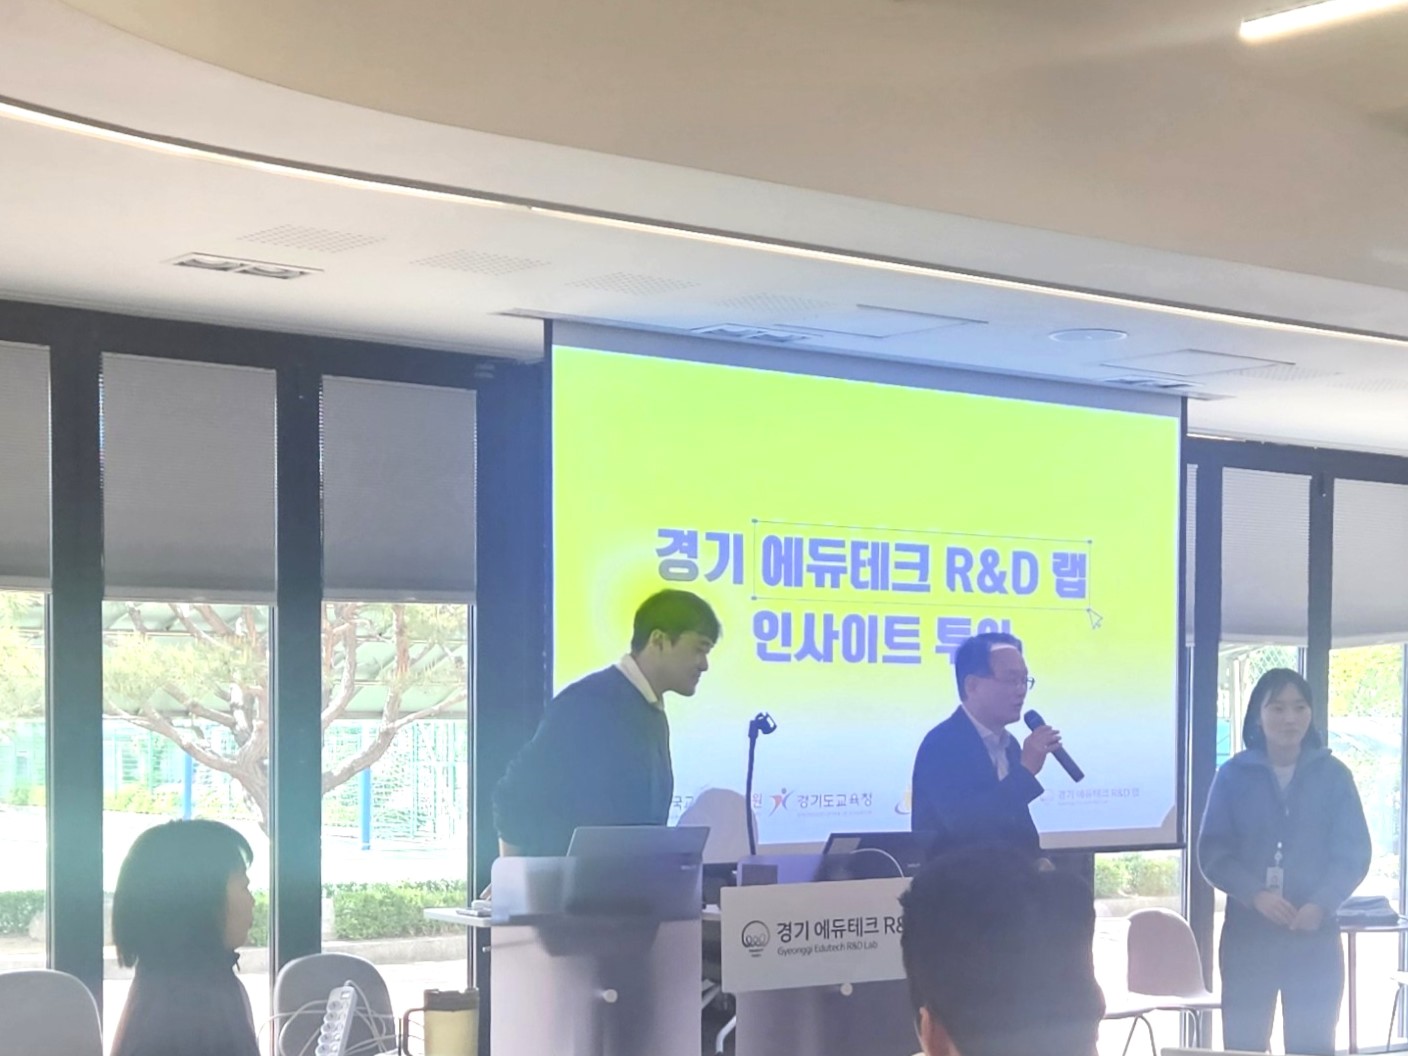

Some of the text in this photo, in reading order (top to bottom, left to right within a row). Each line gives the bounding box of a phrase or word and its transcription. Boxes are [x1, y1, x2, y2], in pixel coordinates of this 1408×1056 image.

[655, 528, 1087, 599] 경기 에듀테크 R&D 랩
[752, 610, 922, 664] 인사이트
[797, 792, 872, 809] 경기도교육청
[776, 916, 903, 943] 경기 에듀테크 R&
[814, 942, 846, 953] Edutech
[864, 940, 878, 950] Lab
